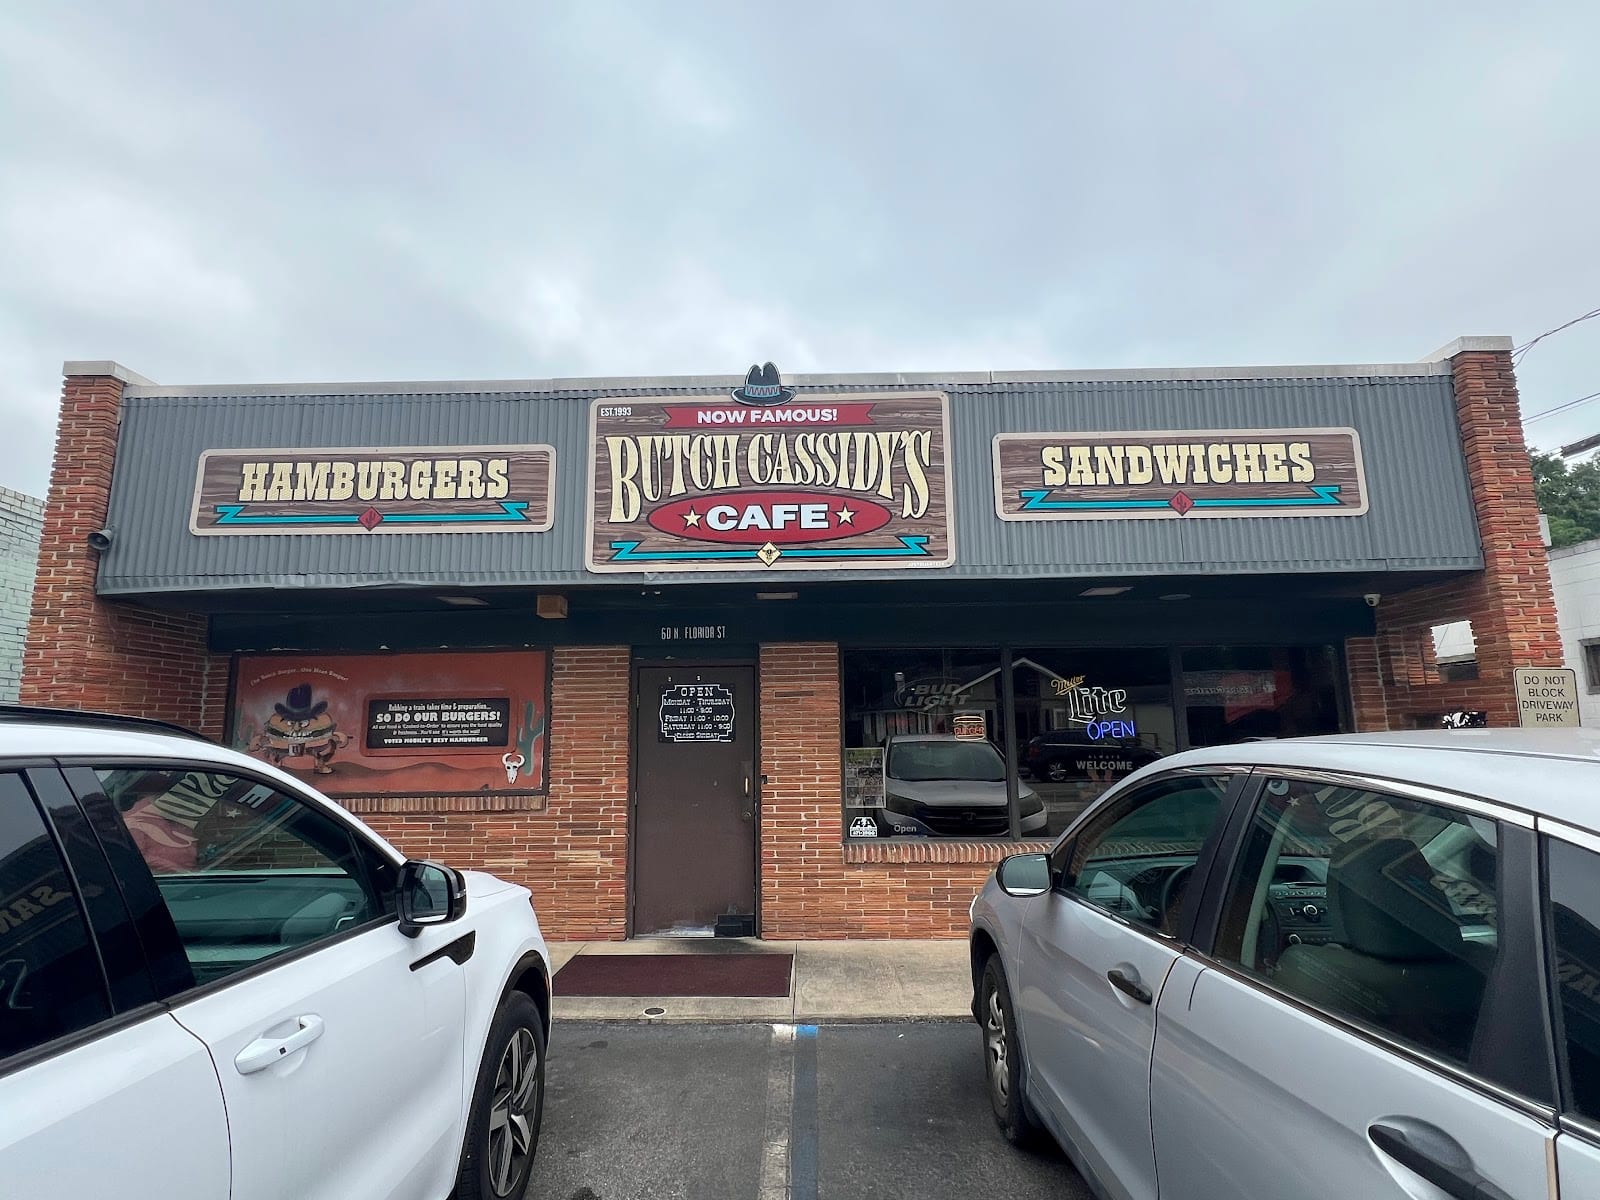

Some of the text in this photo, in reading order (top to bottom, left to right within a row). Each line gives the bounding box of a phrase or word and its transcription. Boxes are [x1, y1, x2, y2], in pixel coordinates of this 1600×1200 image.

[697, 409, 838, 424] NOW FAMOUS!
[1041, 442, 1316, 486] SANDWICHES
[238, 458, 510, 502] HAMBURGERS
[605, 430, 933, 524] BUTCH CASSIDY'S
[705, 503, 830, 532] CAFE
[661, 627, 672, 640] 60
[684, 626, 715, 639] FLORIDA
[1050, 674, 1086, 694] Miller
[1523, 676, 1567, 685] DO NOT
[680, 687, 714, 697] OPEN
[914, 683, 961, 695] BUD
[1528, 688, 1566, 698] BLOCK
[904, 694, 970, 706] LIGHT
[1068, 687, 1127, 724] Lite
[1522, 700, 1574, 710] DRIVEWAY
[388, 704, 408, 712] Robbing
[426, 703, 440, 711] takes
[376, 711, 501, 723] SO DO OUR BURGERS!
[1536, 713, 1564, 722] PARK
[1087, 720, 1136, 741] OPEN
[1076, 760, 1134, 770] WELCOME
[894, 824, 917, 834] Open
